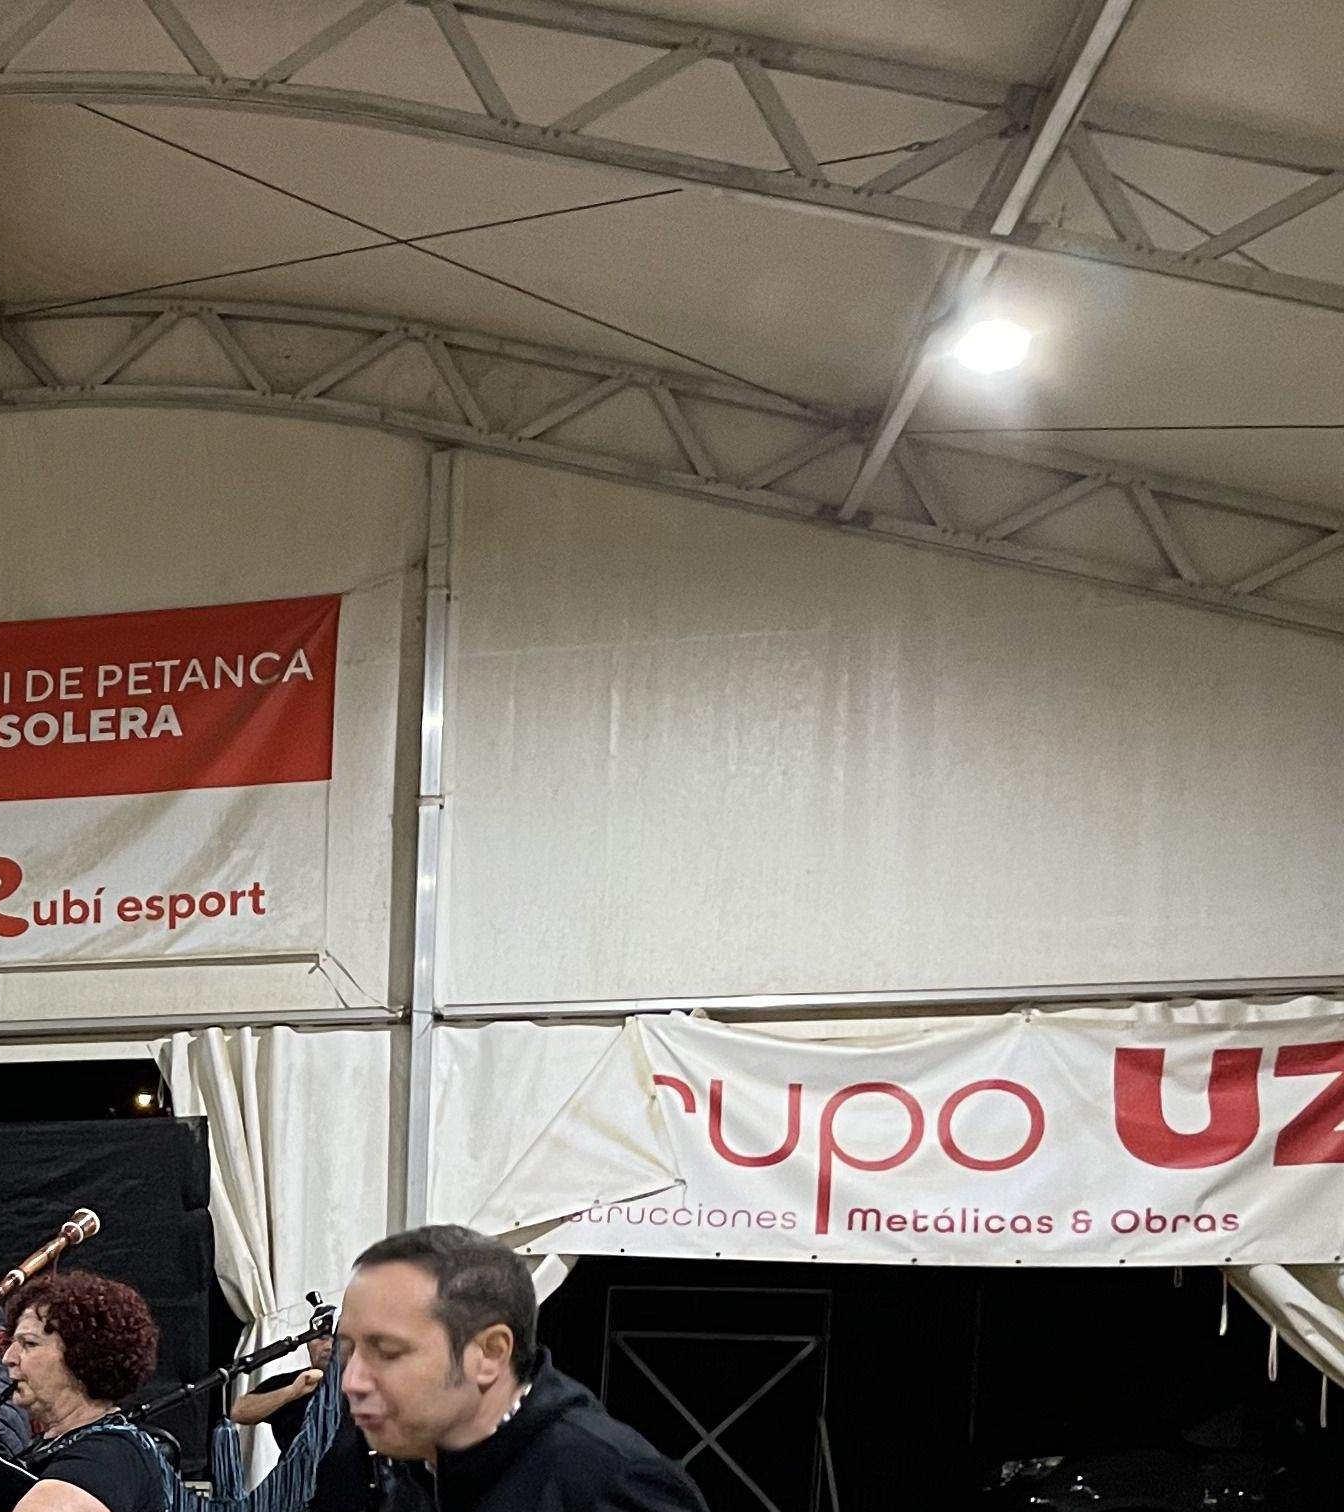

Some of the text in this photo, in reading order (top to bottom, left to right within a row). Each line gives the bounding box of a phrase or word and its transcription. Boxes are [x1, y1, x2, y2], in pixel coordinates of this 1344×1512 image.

[25, 666, 85, 703] DE
[96, 647, 314, 699] PETANCA
[116, 881, 267, 929] esport
[846, 1206, 1054, 1235] Metálicas
[1070, 1209, 1093, 1234] &
[1111, 1207, 1240, 1234] Obras
